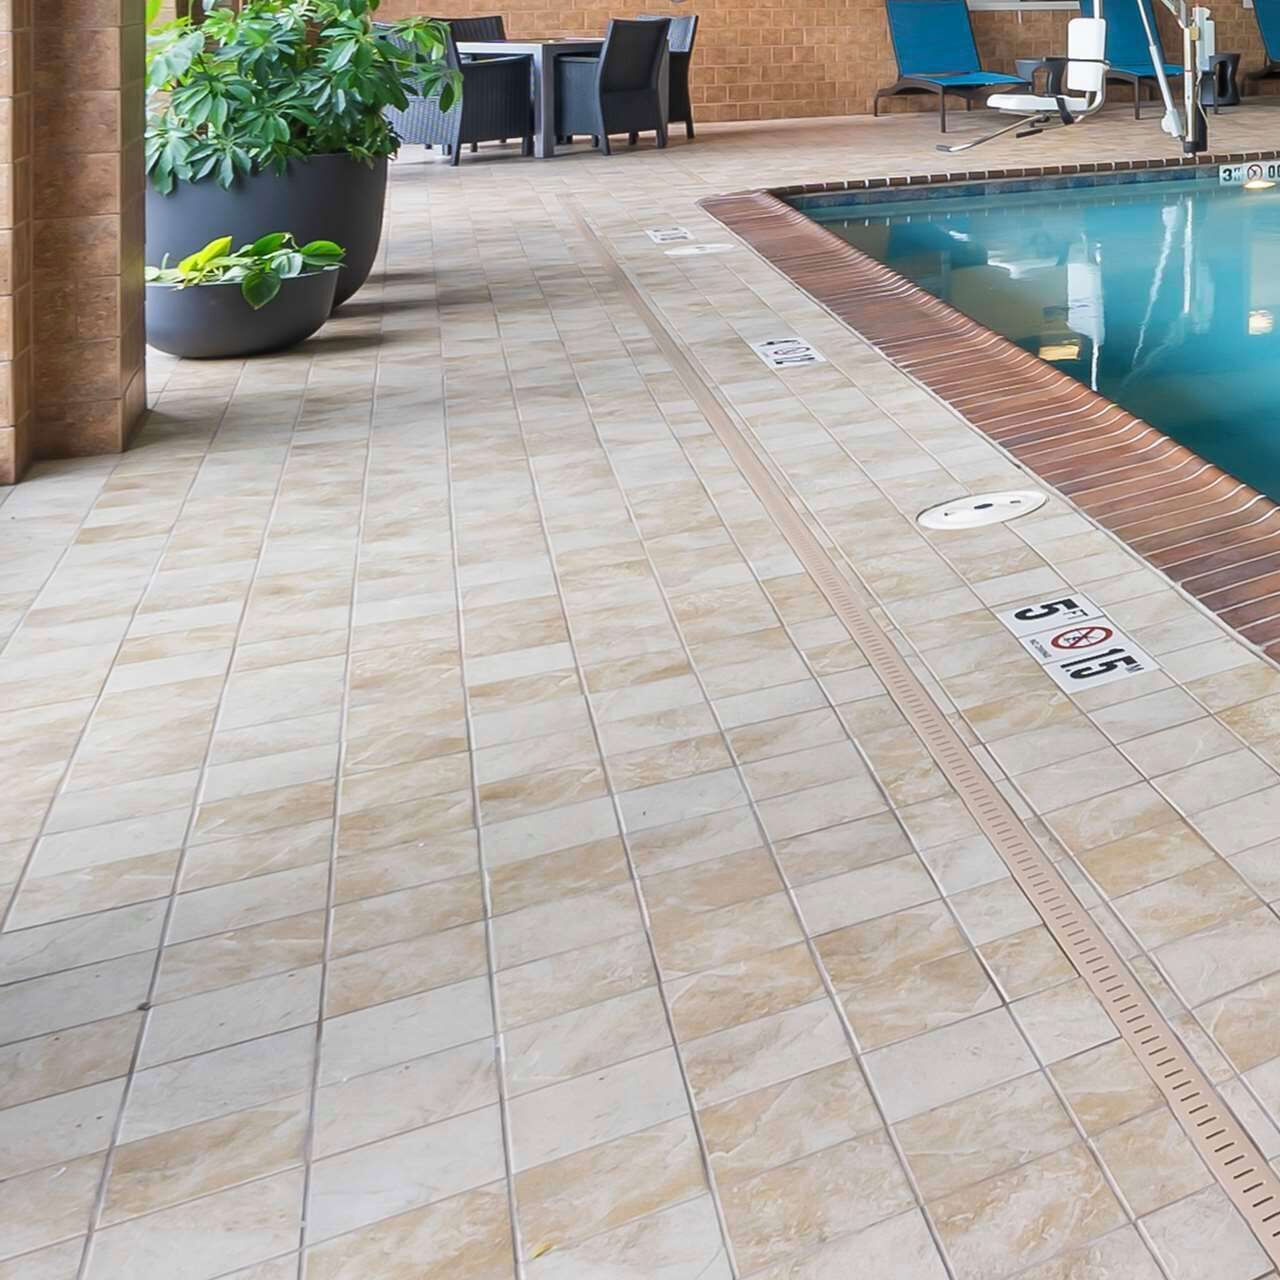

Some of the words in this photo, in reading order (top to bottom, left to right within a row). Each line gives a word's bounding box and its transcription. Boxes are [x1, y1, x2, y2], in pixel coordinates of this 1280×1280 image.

[1222, 167, 1232, 181] 3
[1014, 598, 1081, 621] 5
[1062, 609, 1089, 620] FT
